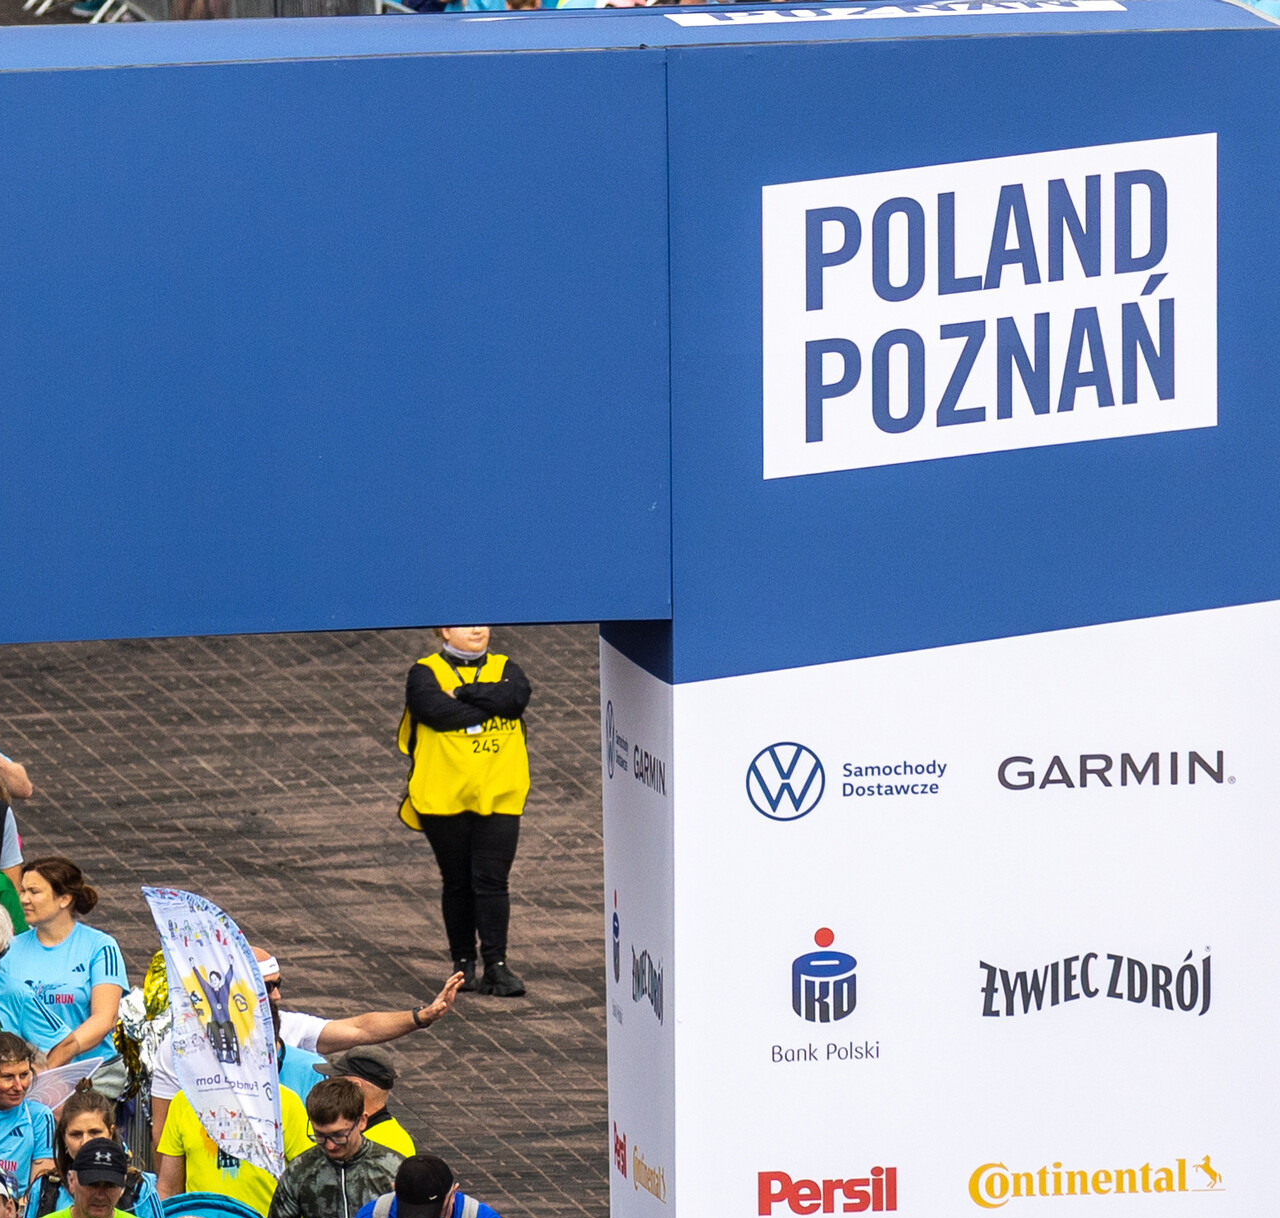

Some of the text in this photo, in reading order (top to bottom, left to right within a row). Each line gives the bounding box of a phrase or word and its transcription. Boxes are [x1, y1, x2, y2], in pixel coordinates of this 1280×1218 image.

[805, 168, 1168, 312] POLAND
[805, 273, 1175, 444] POZNAŃ
[472, 739, 500, 754] 245
[633, 743, 666, 796] GARMIN
[842, 759, 948, 780] Samochody
[997, 749, 1225, 791] GARMIN
[842, 779, 940, 798] Dostawcze
[55, 993, 74, 1005] RUN
[979, 949, 1213, 1017] ŻYWIEC ZDRÓJ
[771, 1041, 880, 1063] Bank Polski
[757, 1165, 898, 1217] Persil
[968, 1157, 1188, 1209] Continental
